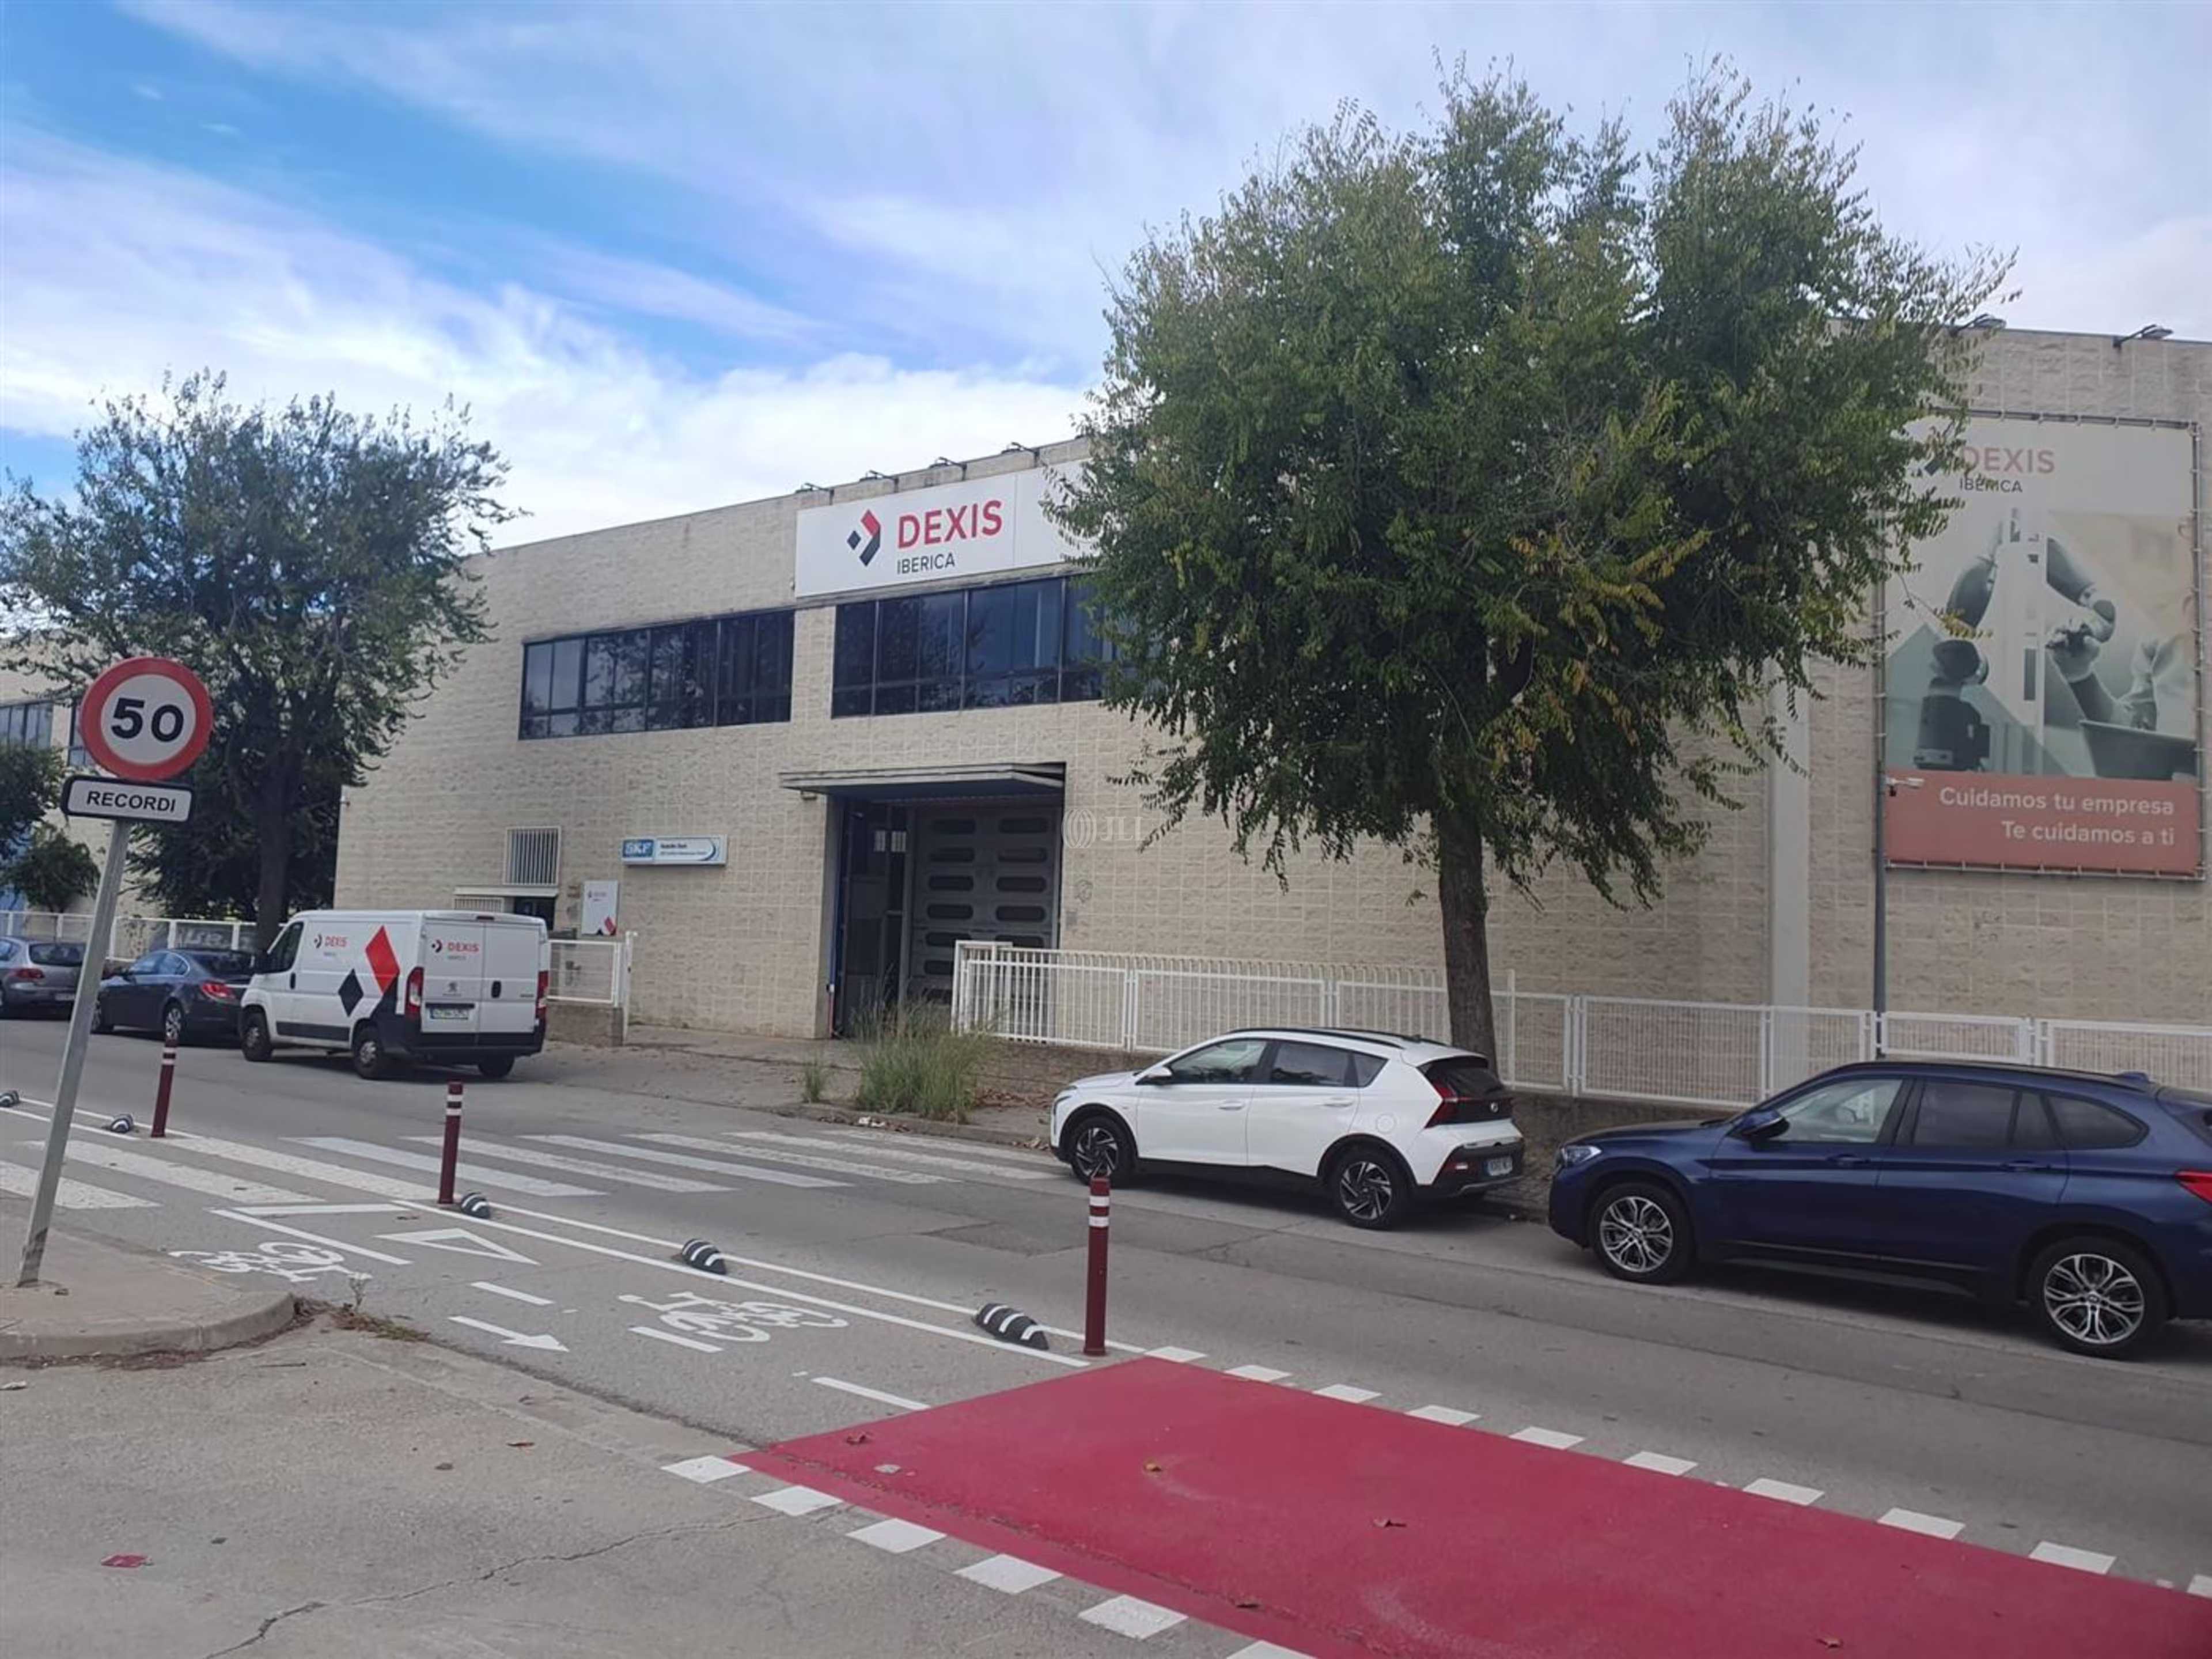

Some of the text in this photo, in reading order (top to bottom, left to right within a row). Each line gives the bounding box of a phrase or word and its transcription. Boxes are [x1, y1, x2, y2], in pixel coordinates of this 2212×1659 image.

[1959, 446, 2055, 474] DEXIS
[898, 500, 1002, 549] DEXIS
[897, 552, 955, 574] IBERICA
[111, 697, 184, 742] 50
[86, 790, 176, 812] RECORDI
[1940, 787, 2174, 816] Cuidamos tu empresa
[2001, 820, 2175, 846] Te cuidamos a ti
[625, 842, 651, 854] SKF
